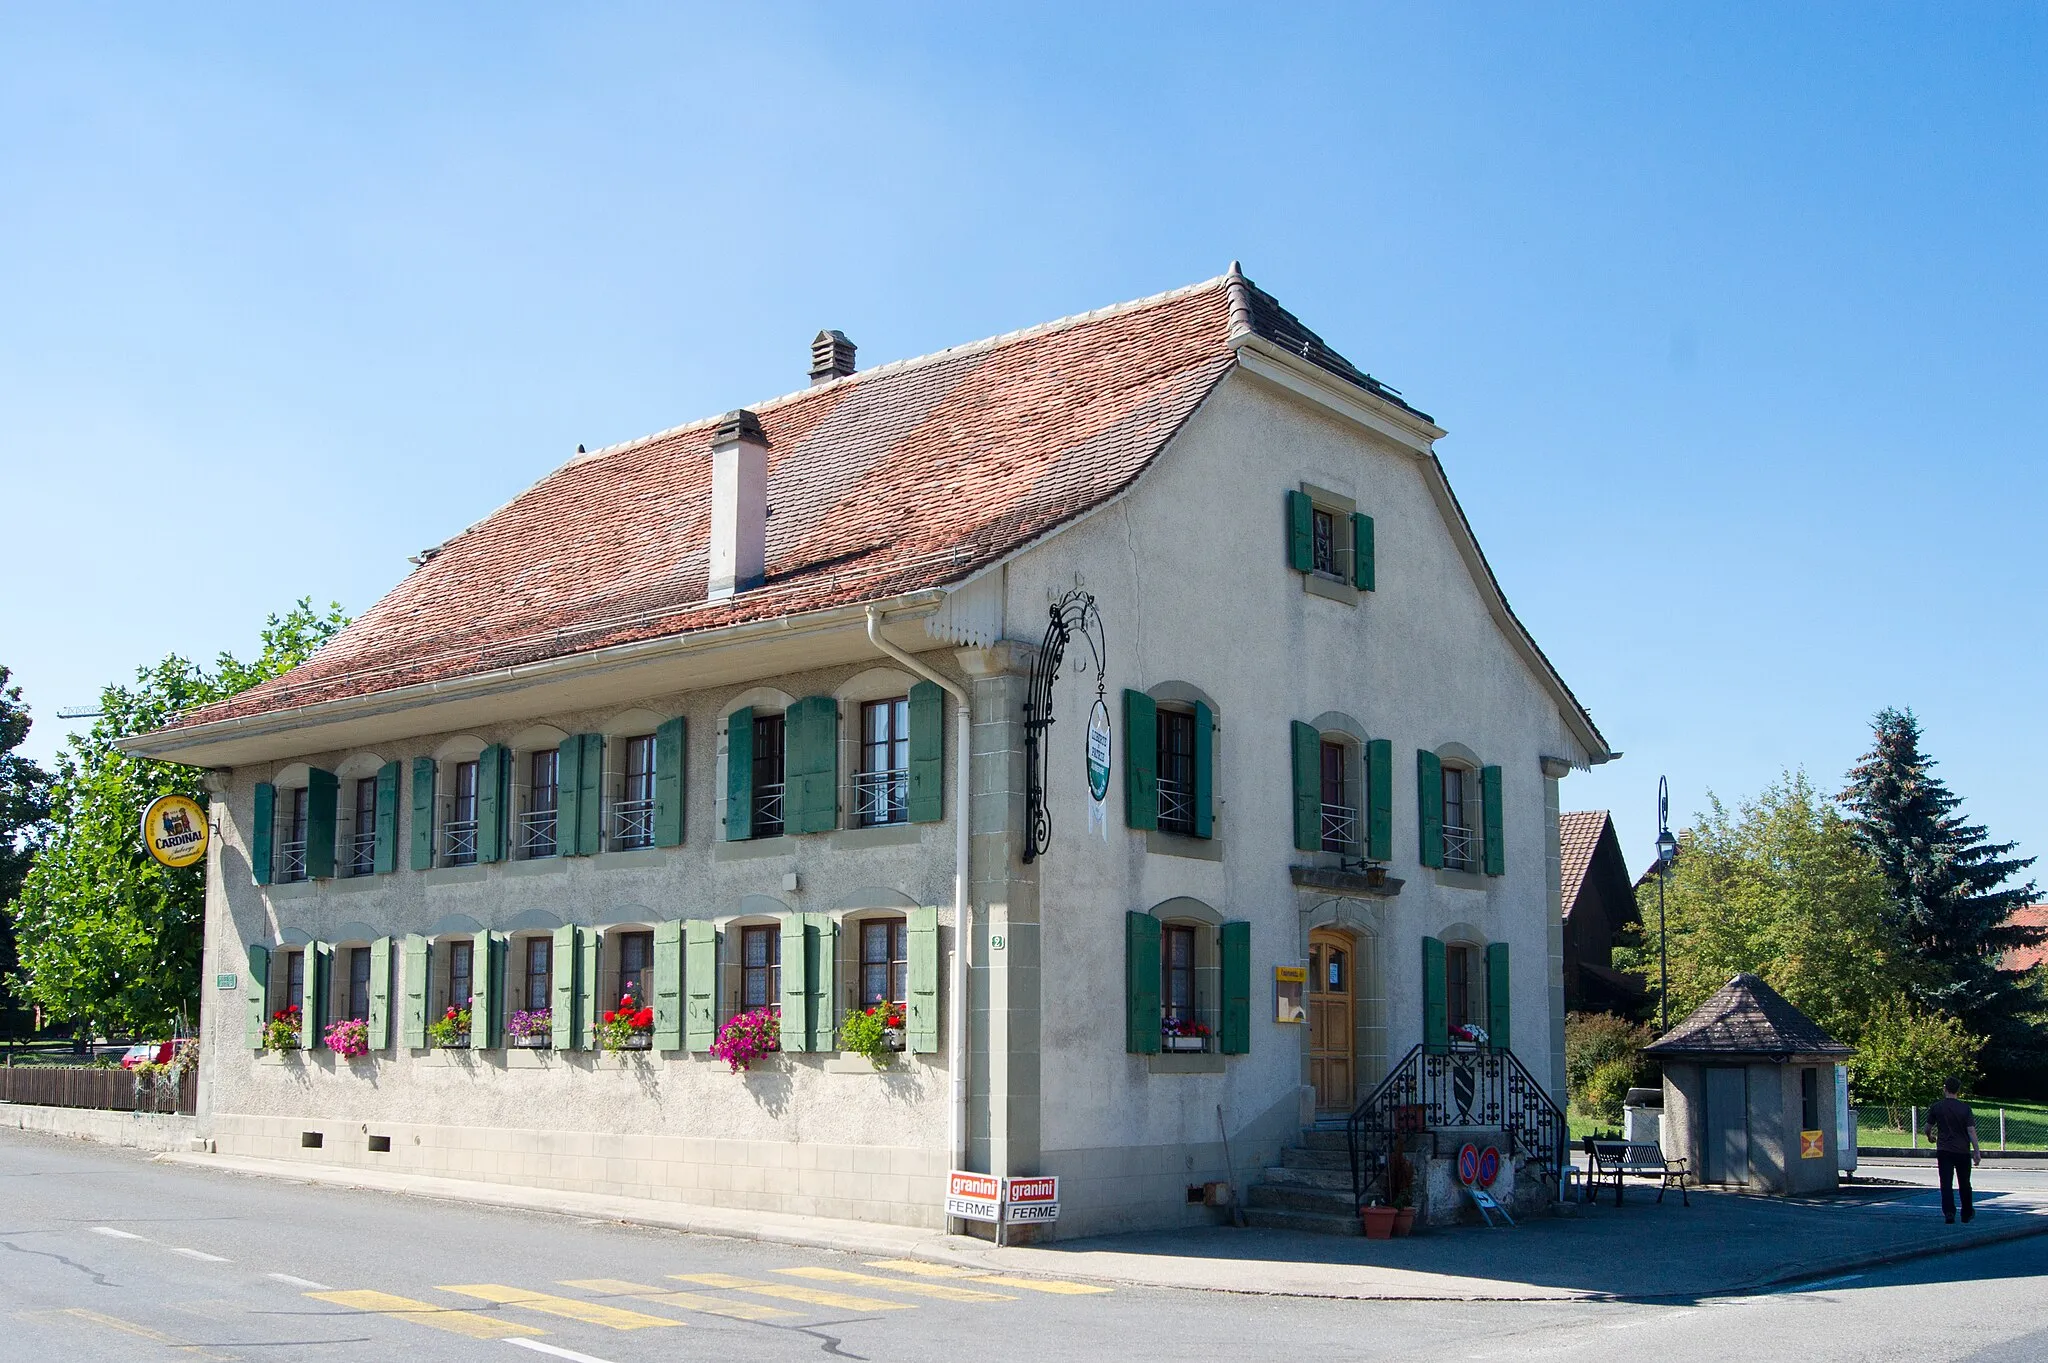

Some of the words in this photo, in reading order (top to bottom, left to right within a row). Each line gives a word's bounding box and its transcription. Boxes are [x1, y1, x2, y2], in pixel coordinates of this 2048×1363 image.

[155, 831, 205, 850] CARDINAL
[994, 936, 1001, 947] 2
[953, 1177, 996, 1195] granini
[1012, 1181, 1053, 1201] granini
[948, 1199, 995, 1217] FERMÉ
